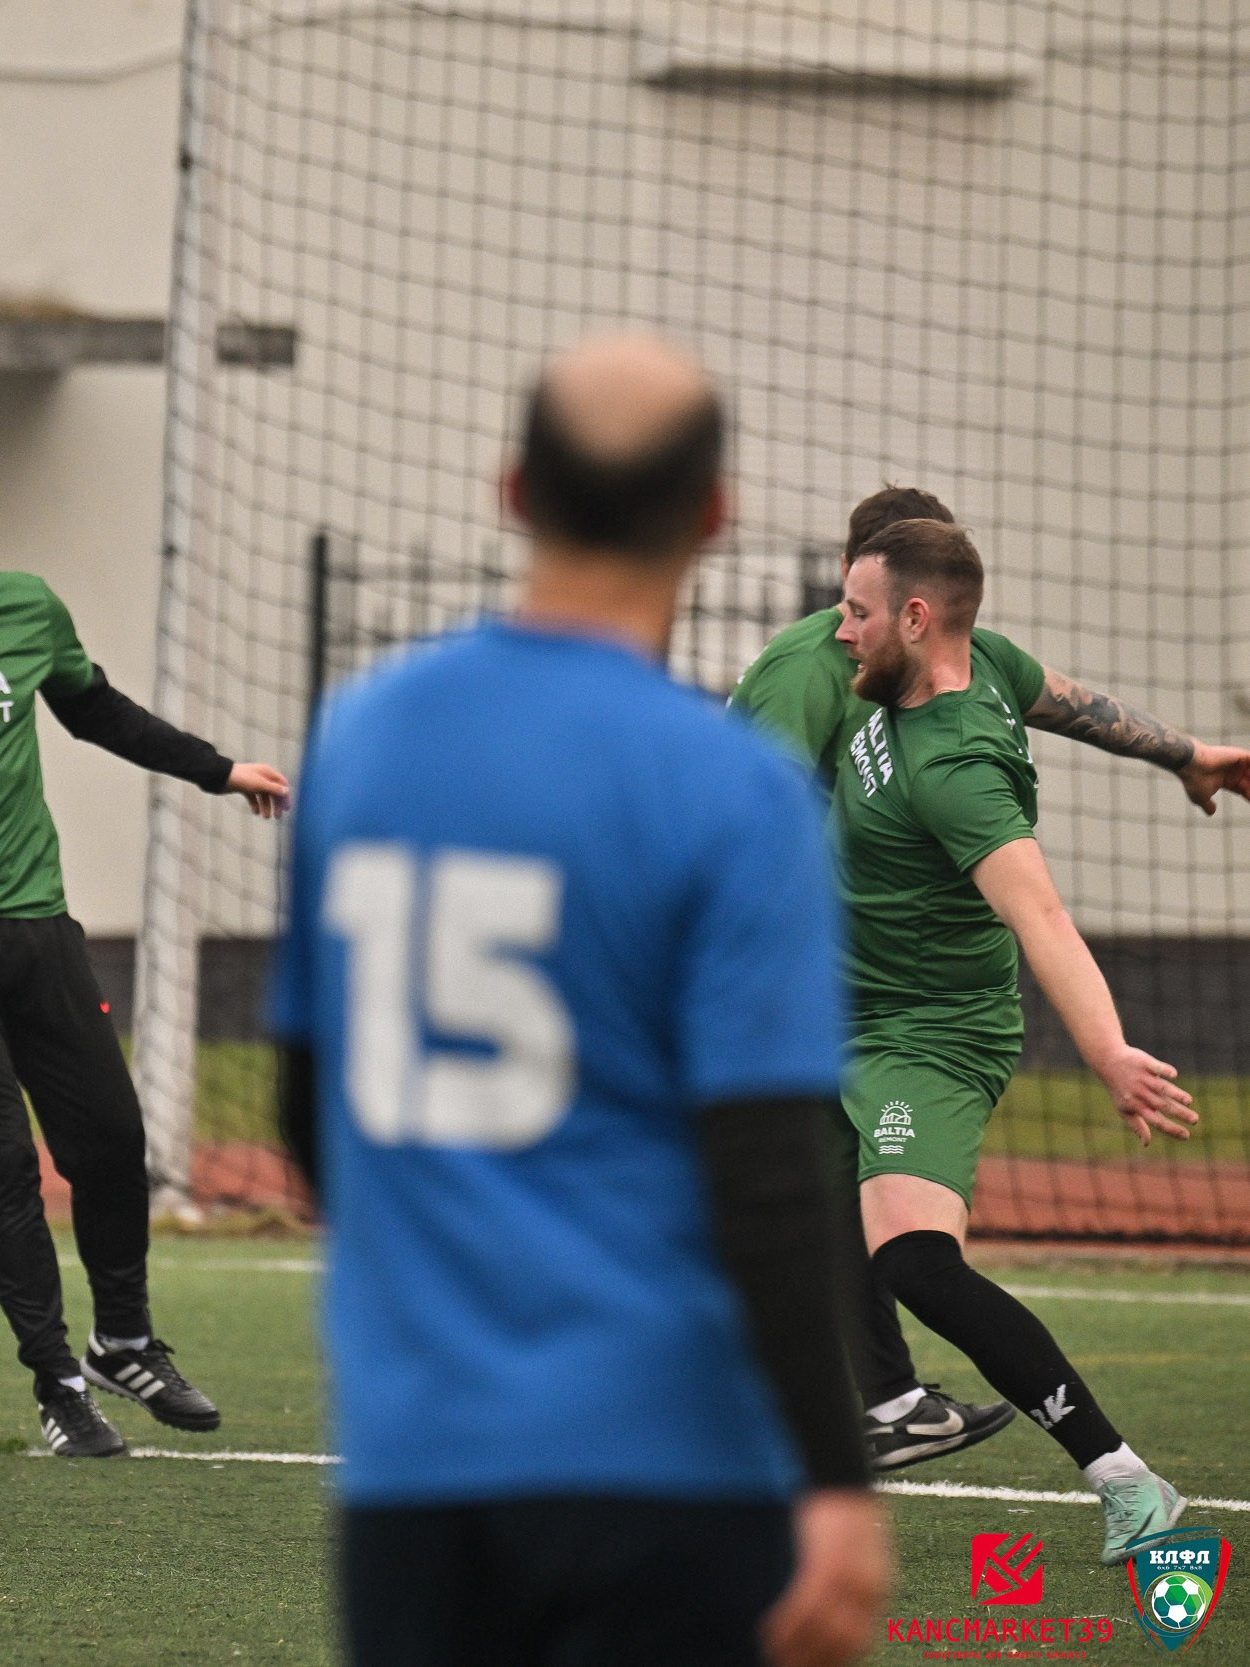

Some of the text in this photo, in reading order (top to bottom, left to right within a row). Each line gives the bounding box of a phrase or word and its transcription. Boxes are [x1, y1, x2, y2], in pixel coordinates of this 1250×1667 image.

[850, 725, 878, 798] EMONT
[868, 707, 894, 786] ALTIA
[319, 841, 578, 1151] 15
[873, 1126, 916, 1138] BALTIA
